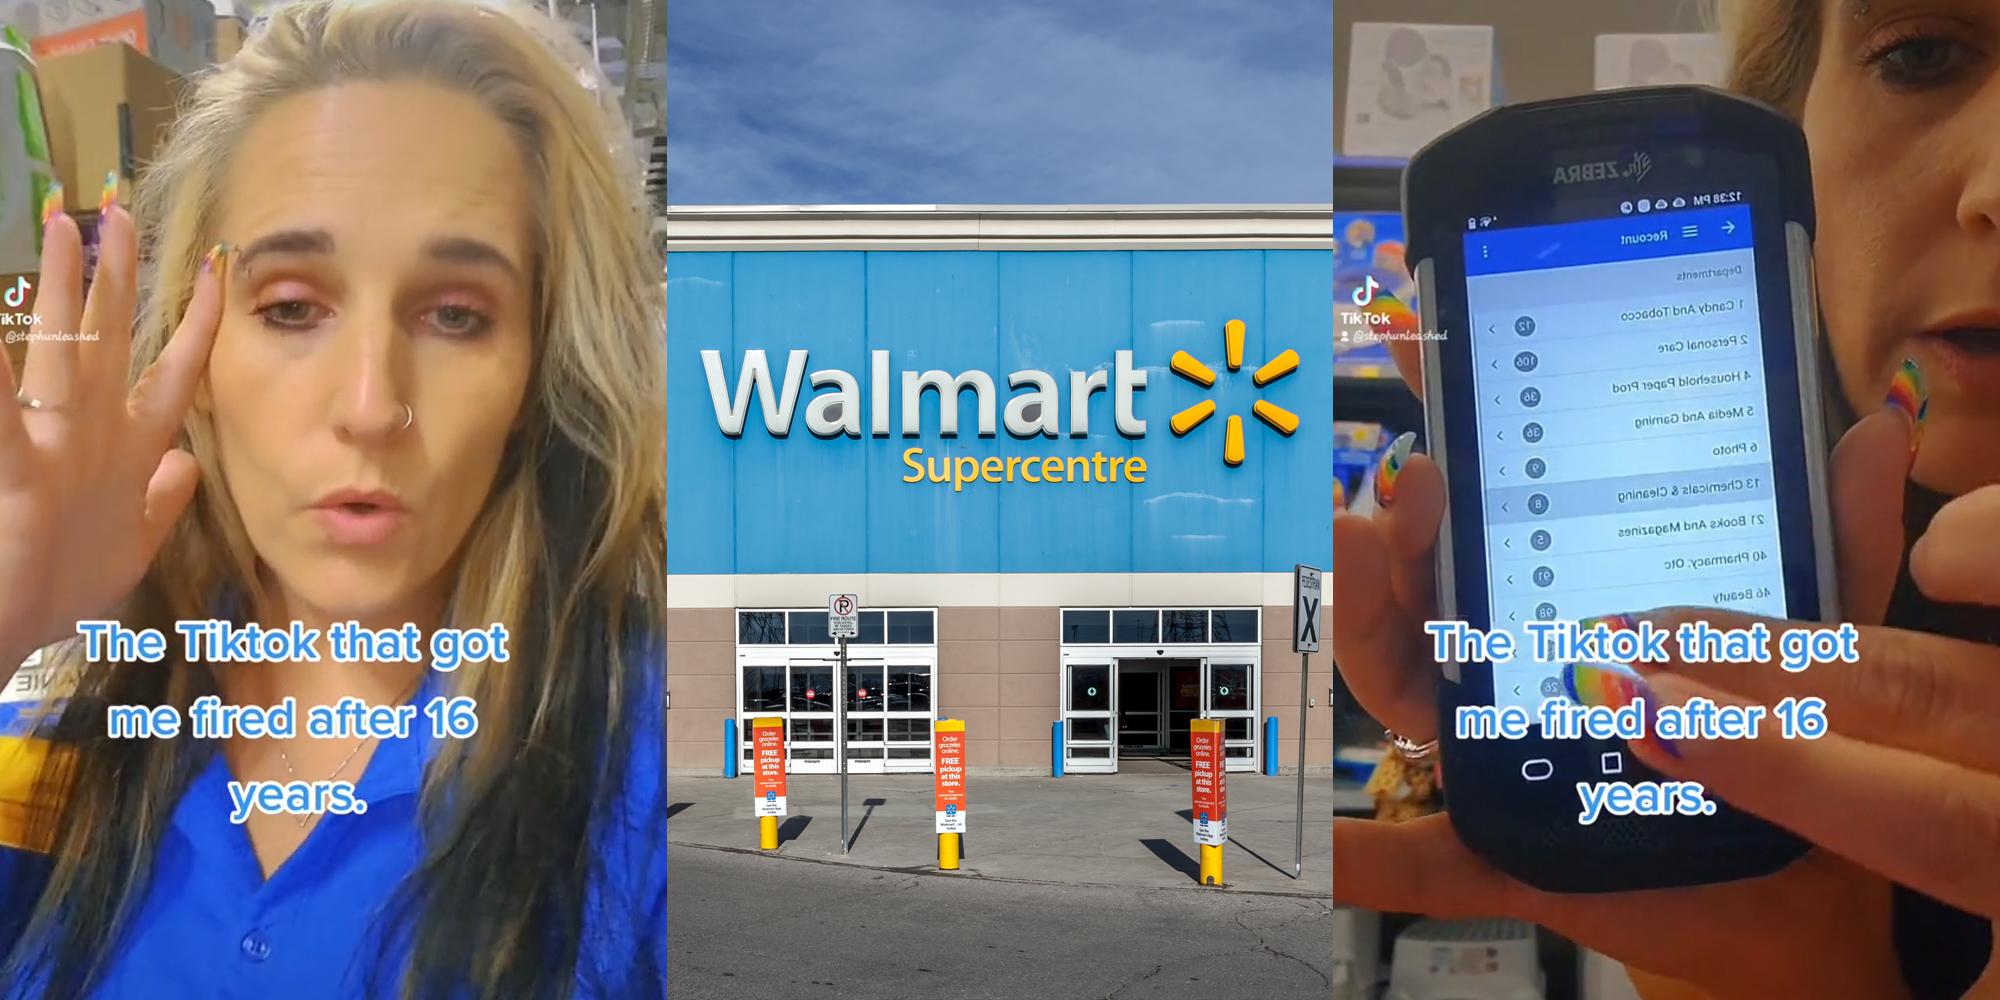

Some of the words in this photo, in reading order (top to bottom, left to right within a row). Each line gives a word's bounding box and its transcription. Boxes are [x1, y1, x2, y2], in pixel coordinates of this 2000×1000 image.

[700, 349, 1147, 438] Walmart
[902, 448, 1147, 491] Supercentre
[1300, 596, 1319, 643] X
[940, 766, 962, 774] pickup
[1194, 770, 1212, 779] pickup
